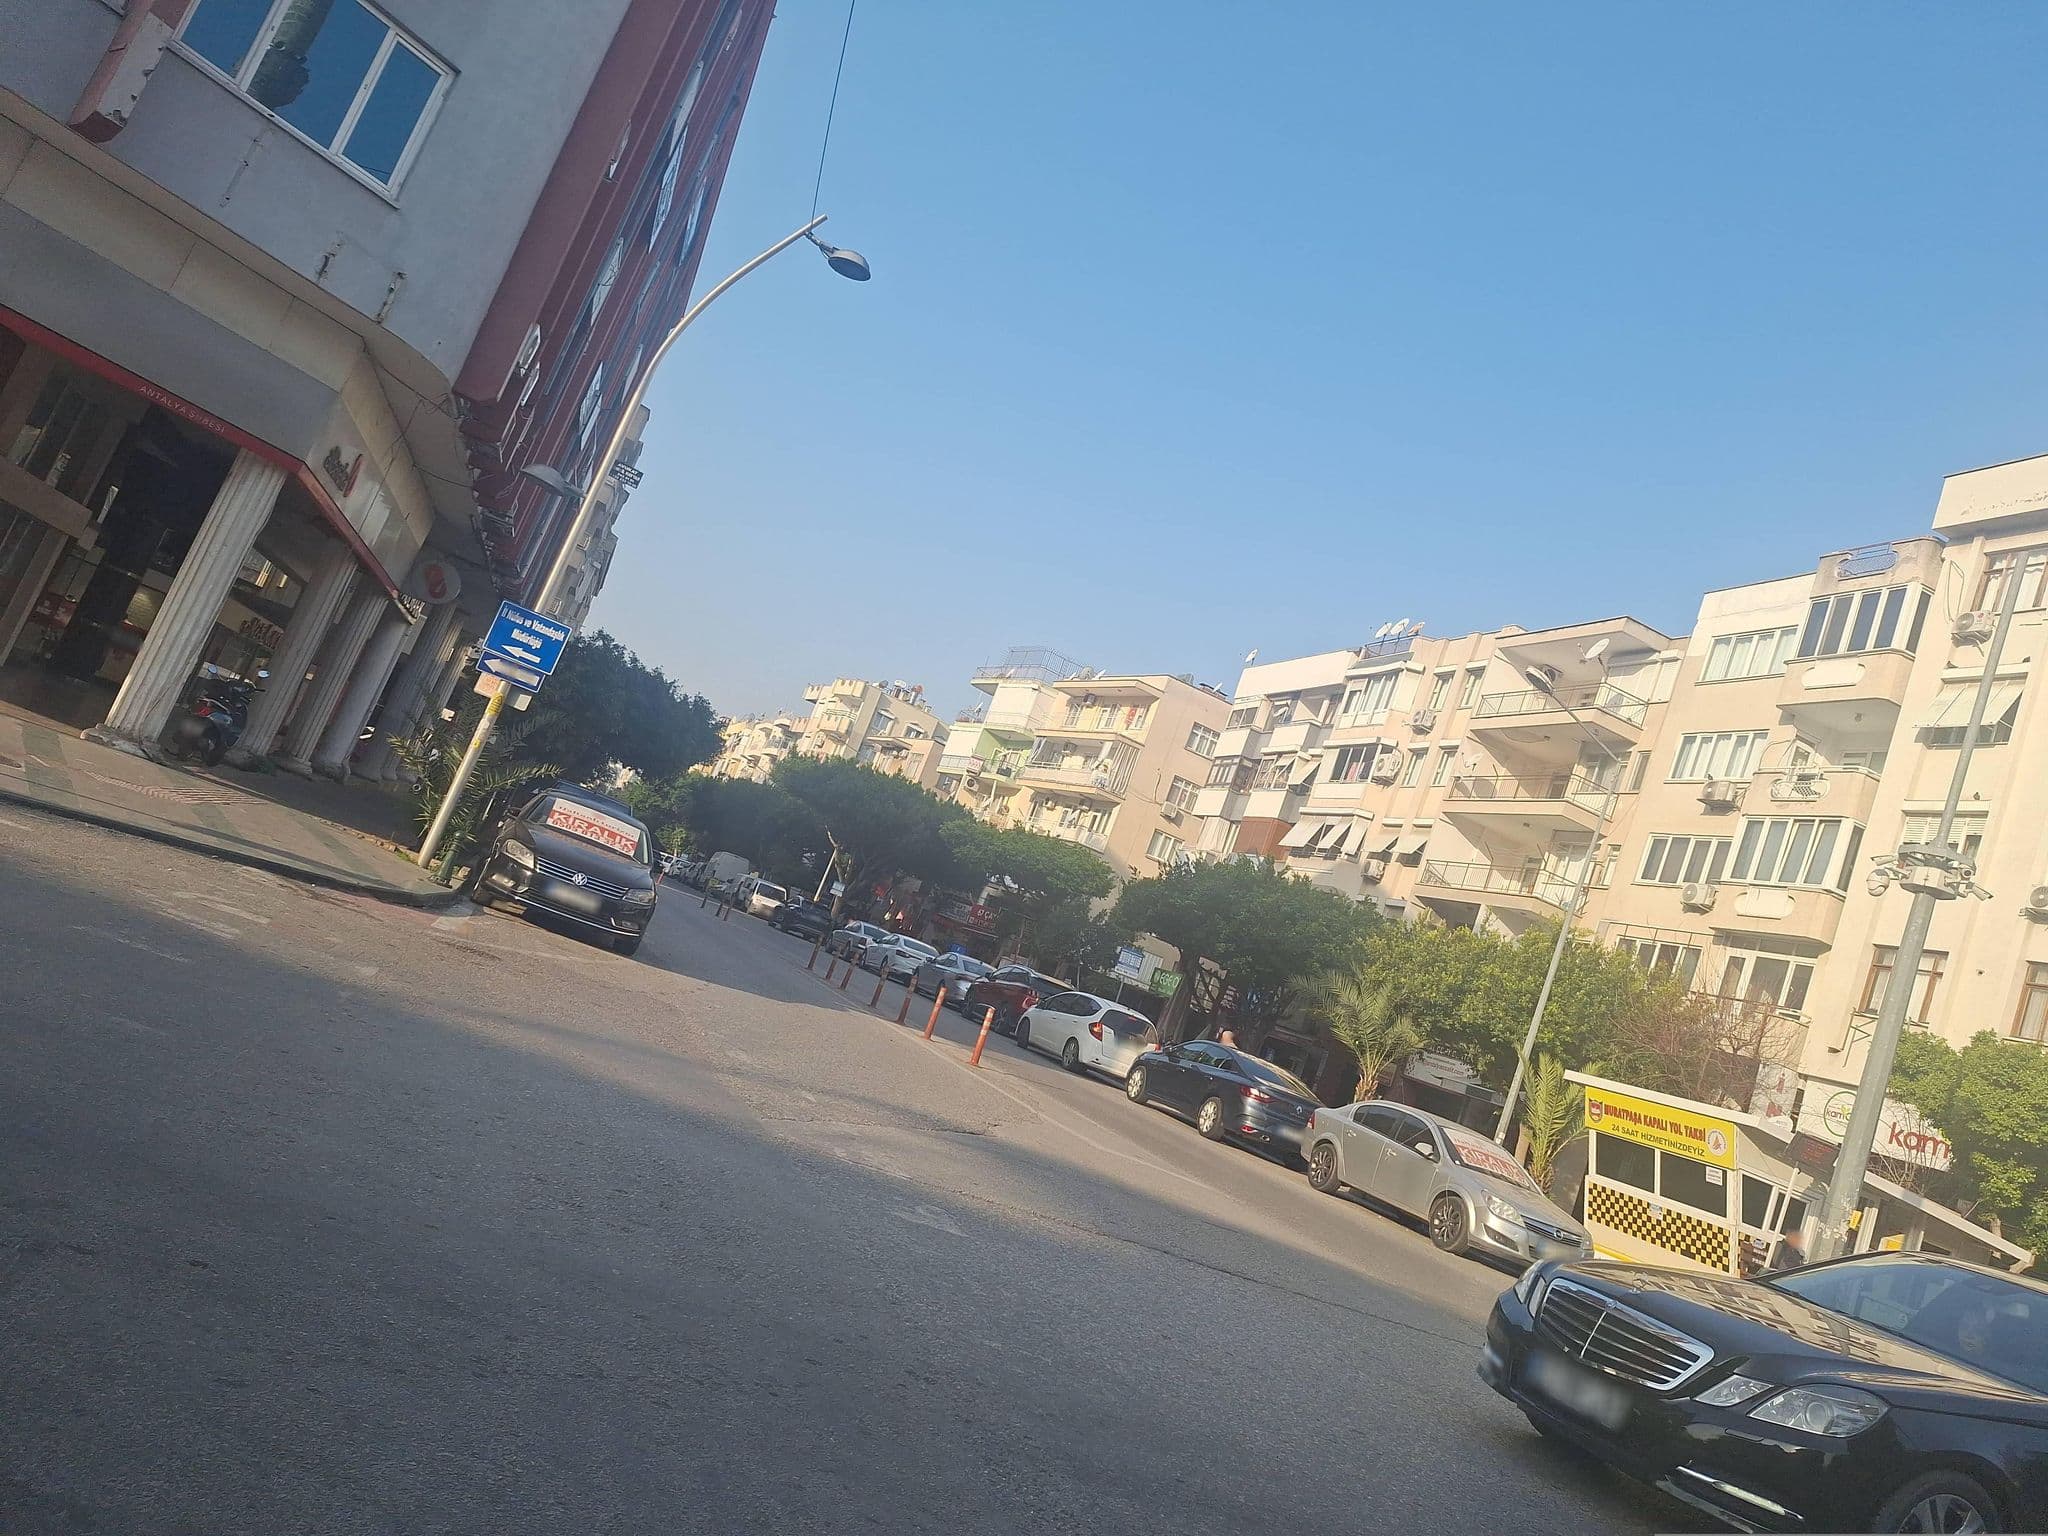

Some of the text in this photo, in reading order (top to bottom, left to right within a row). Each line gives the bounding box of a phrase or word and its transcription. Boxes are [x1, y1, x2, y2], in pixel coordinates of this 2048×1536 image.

[139, 385, 186, 414] ANTALYA
[524, 618, 532, 628] ve
[552, 811, 635, 850] KIRALIK
[1604, 1103, 1706, 1143] MURATPAŞA KAPALI YOL TAKSİ
[1611, 1123, 1705, 1157] 24 SAAT HİZMETİNİZDEYİZ
